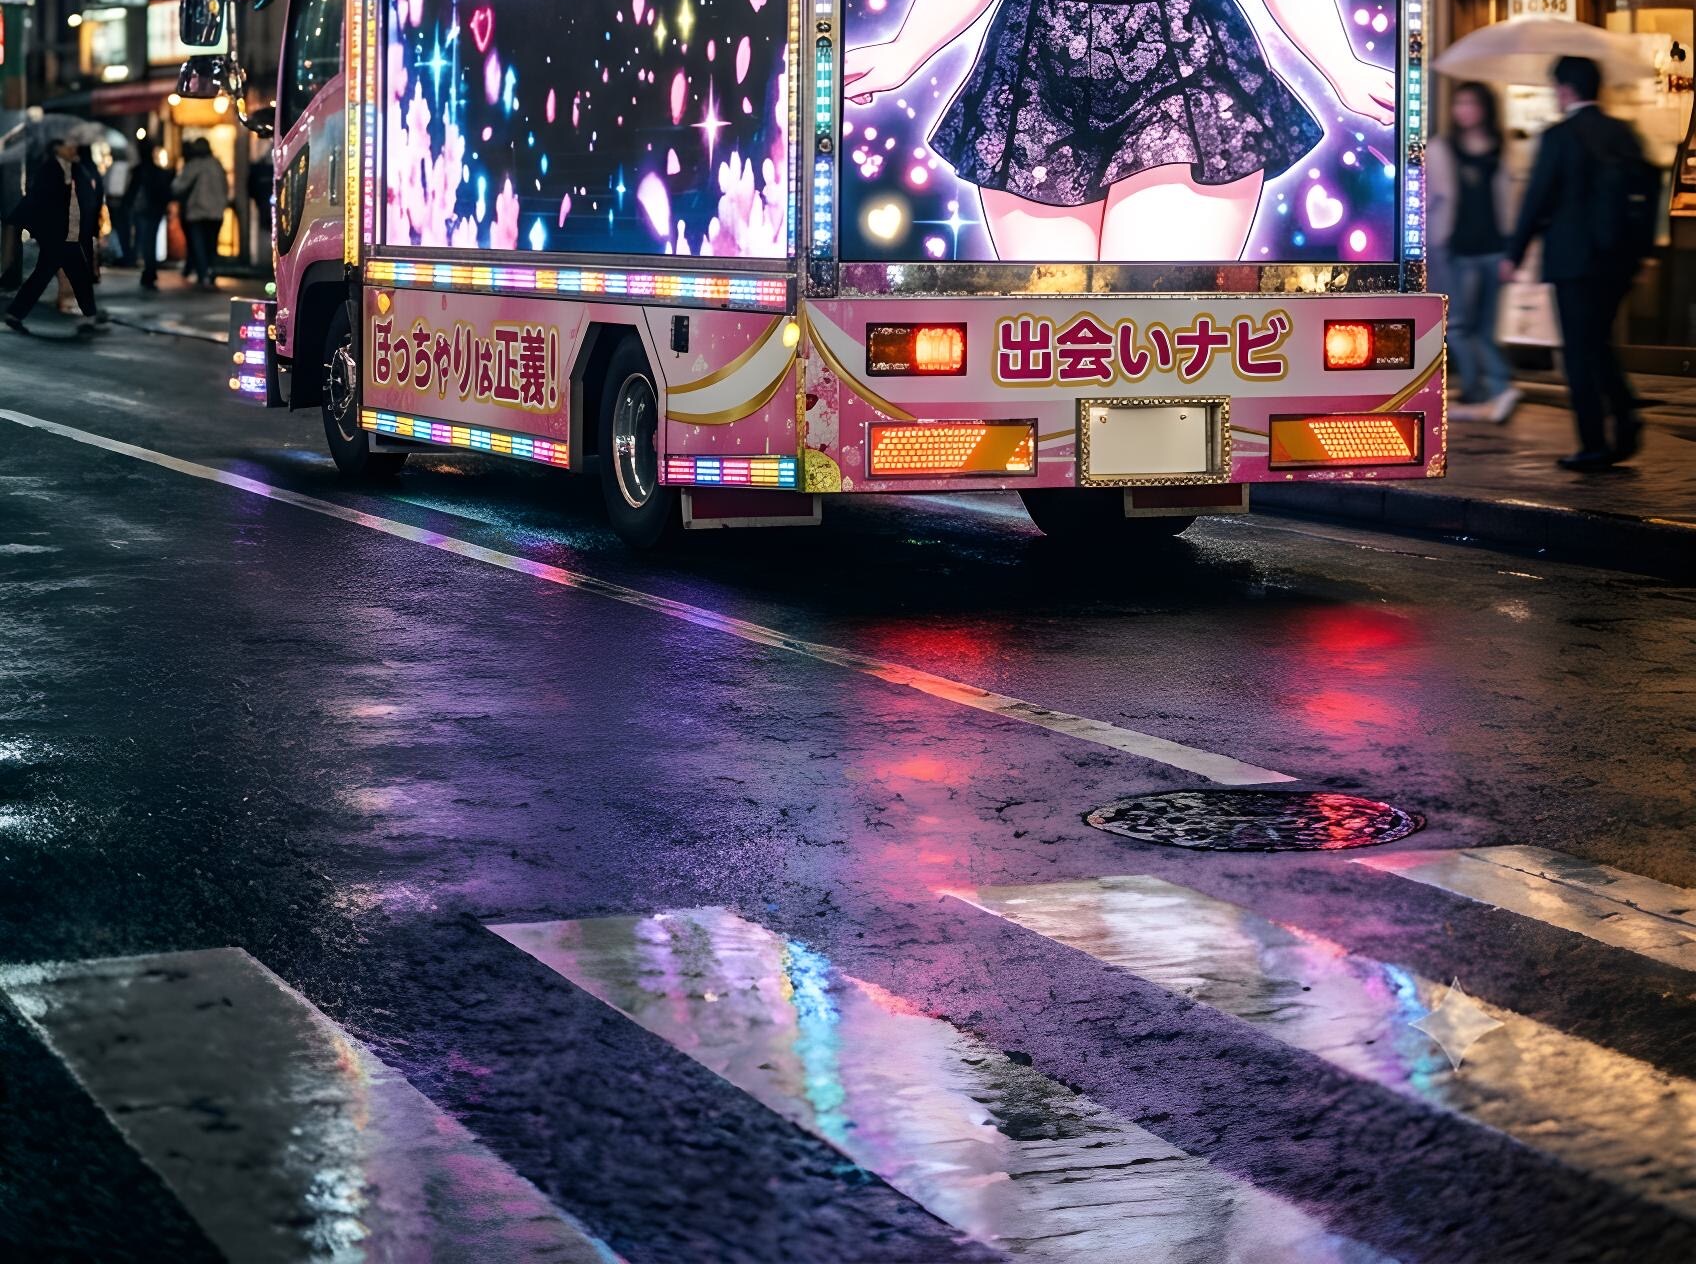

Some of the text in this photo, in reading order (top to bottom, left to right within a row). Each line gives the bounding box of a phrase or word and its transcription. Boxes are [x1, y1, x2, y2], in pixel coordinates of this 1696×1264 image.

[995, 311, 1292, 386] 出会いナビ
